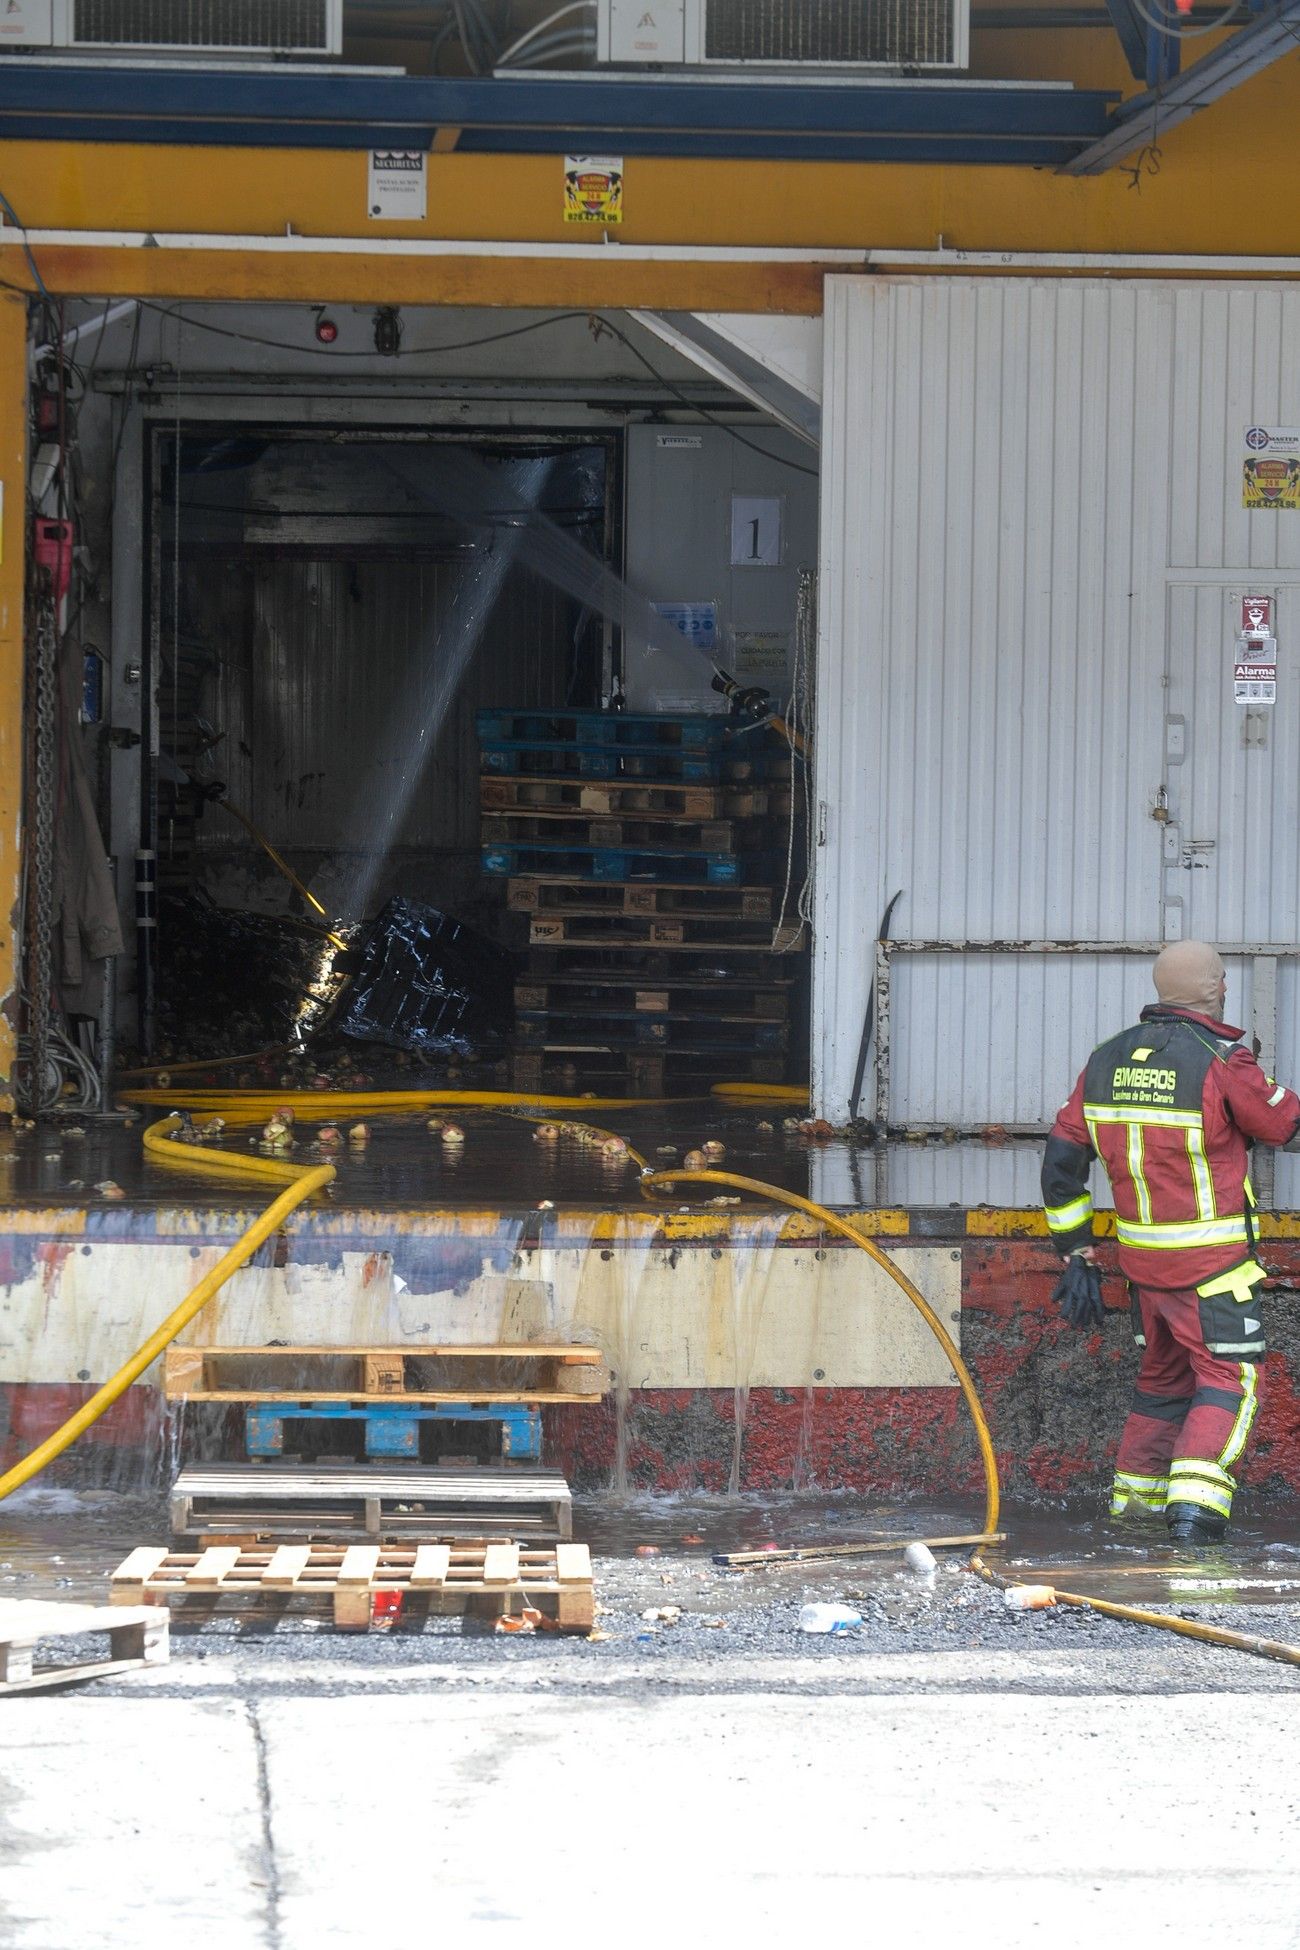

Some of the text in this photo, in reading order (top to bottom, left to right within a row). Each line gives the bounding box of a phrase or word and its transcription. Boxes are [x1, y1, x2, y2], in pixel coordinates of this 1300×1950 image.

[375, 159, 421, 169] SECURITAS
[747, 518, 763, 560] 1
[1236, 666, 1275, 676] Alarma
[1152, 1091, 1175, 1104] Canaria
